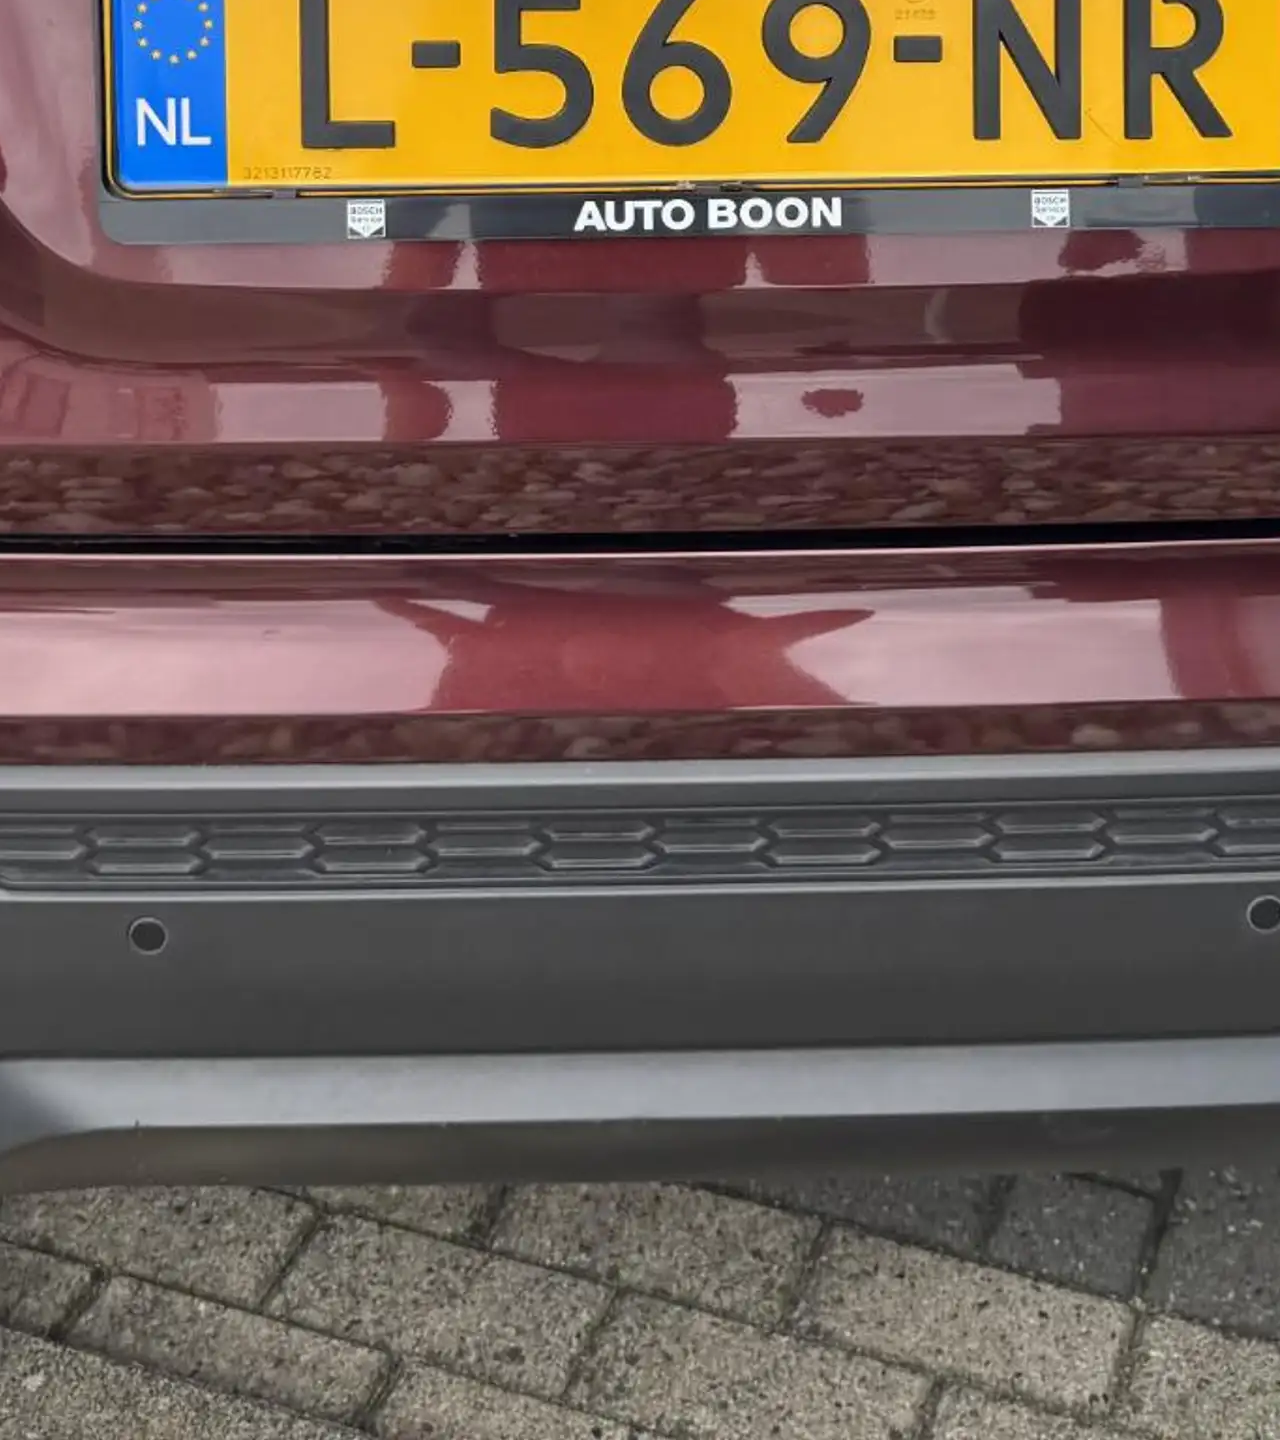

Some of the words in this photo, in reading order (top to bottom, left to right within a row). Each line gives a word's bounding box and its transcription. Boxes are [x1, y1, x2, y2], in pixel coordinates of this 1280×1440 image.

[136, 97, 212, 147] NL
[574, 199, 696, 232] AUTO
[707, 196, 842, 230] BOON
